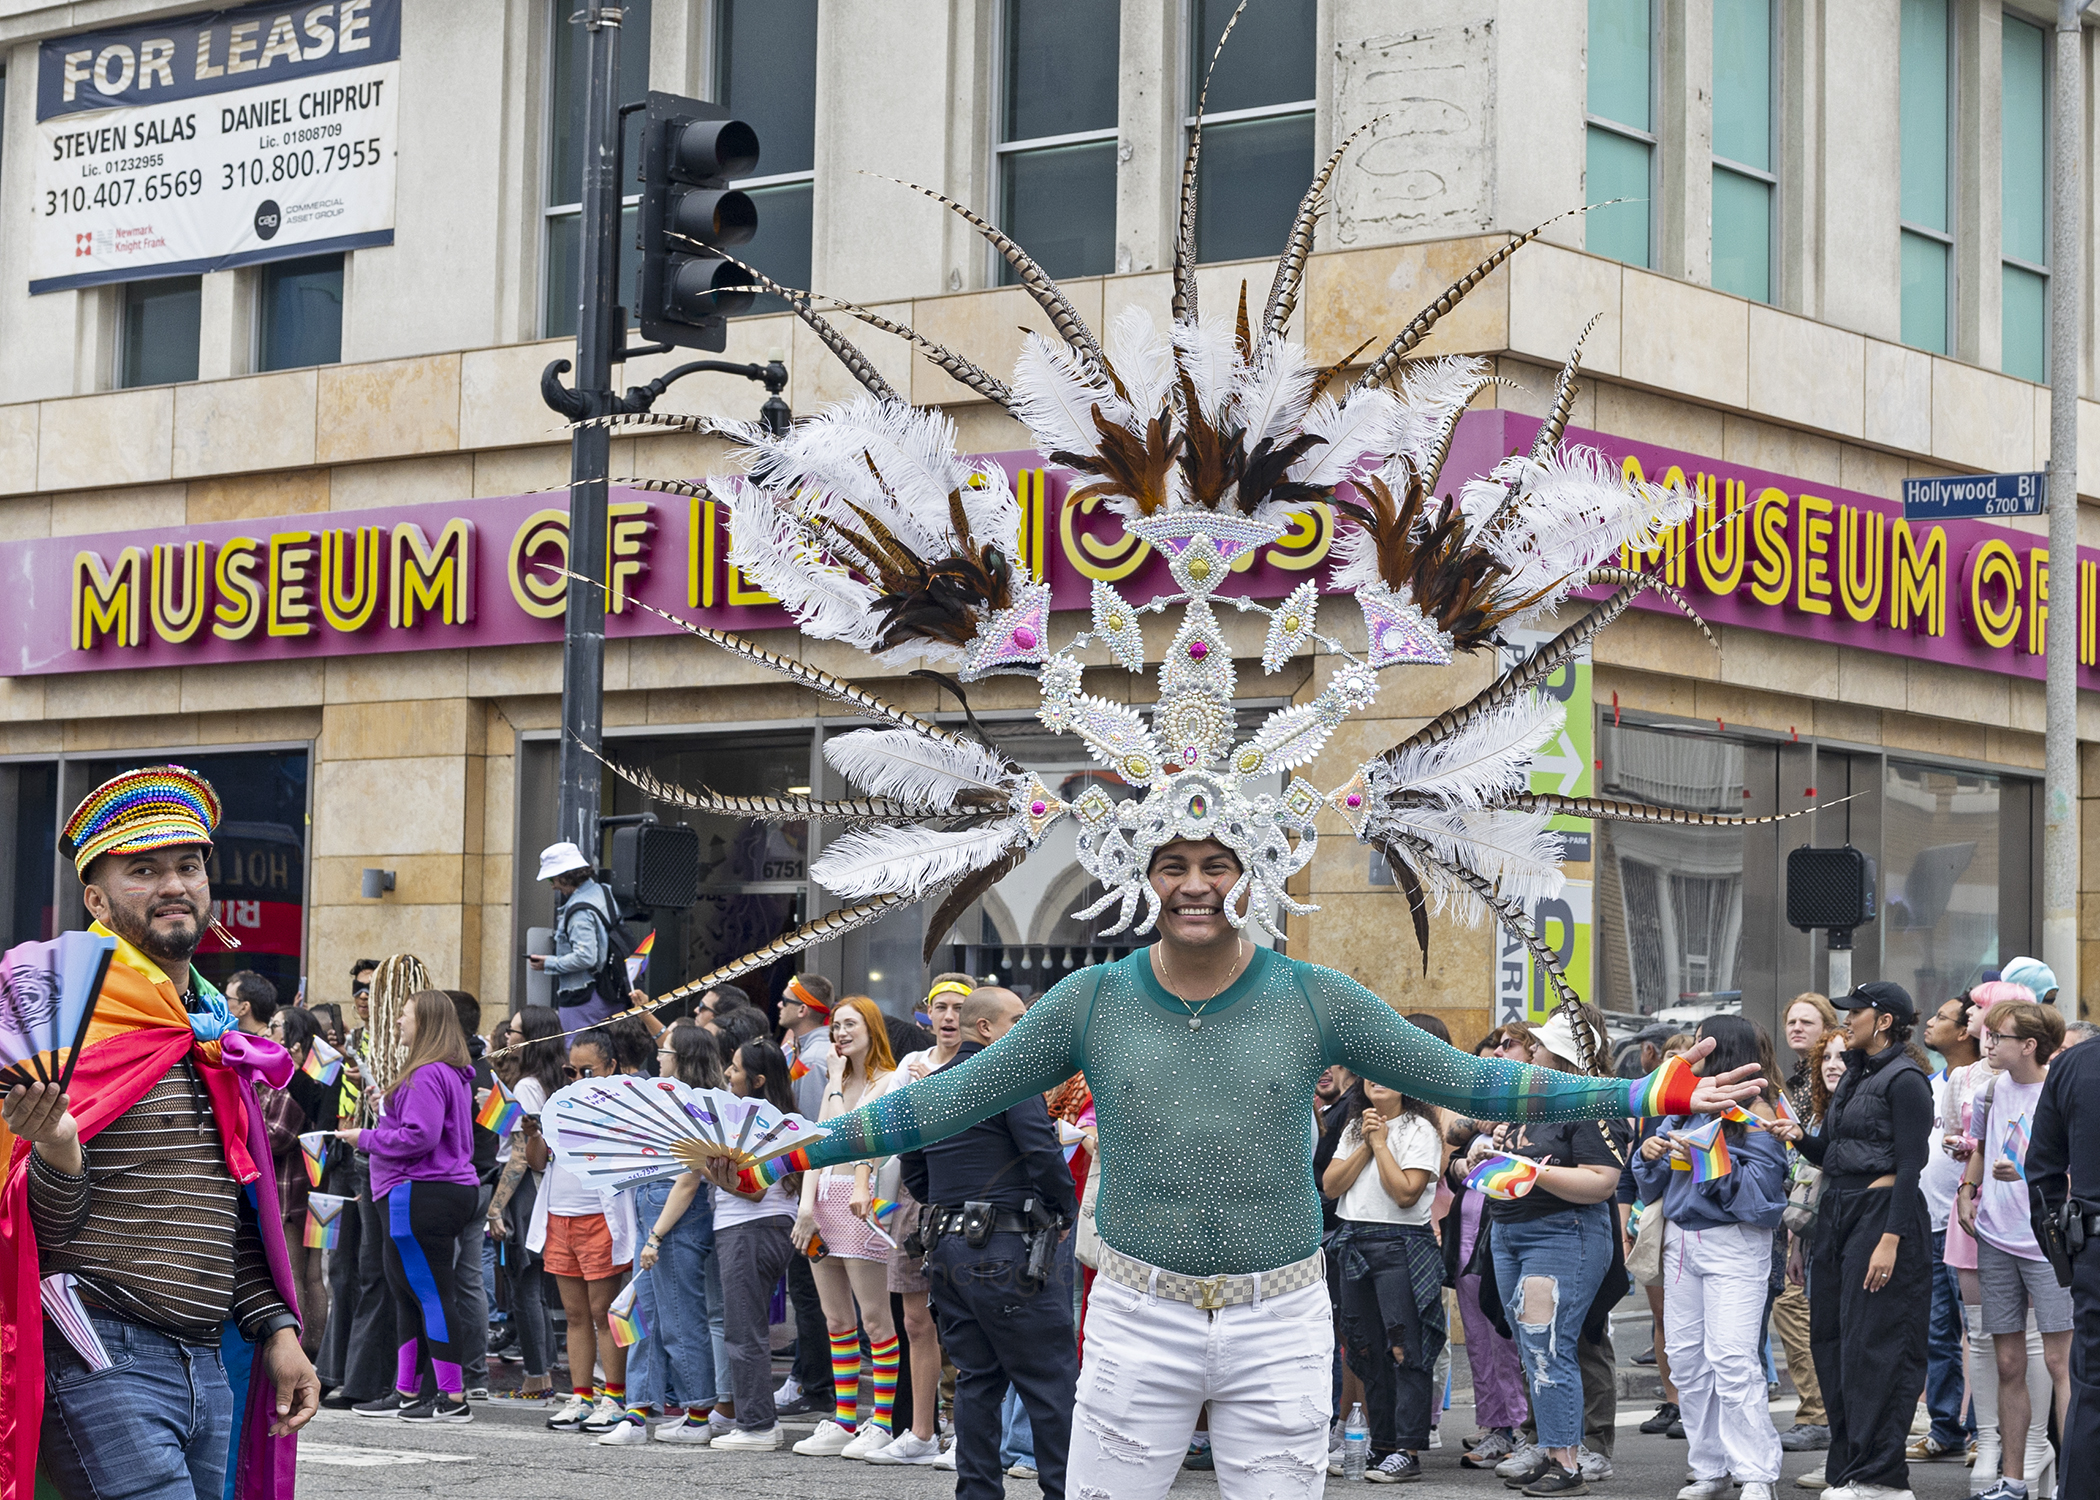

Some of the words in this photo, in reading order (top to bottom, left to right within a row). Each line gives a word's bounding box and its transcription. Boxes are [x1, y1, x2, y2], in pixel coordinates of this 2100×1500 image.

[63, 38, 175, 102] FOR
[194, 0, 372, 81] LEASE
[221, 97, 292, 134] DANIEL
[299, 80, 384, 120] CHIPRUT
[53, 125, 127, 161] STEVEN
[134, 114, 196, 148] SALAS
[259, 135, 280, 150] Lic.
[283, 123, 342, 145] 01808709
[82, 164, 102, 178] Lic.
[105, 153, 164, 174] 01232955
[221, 138, 381, 190] 310.800.7955
[45, 169, 202, 217] 310.407.6569
[285, 198, 344, 214] COMMERCIAL
[286, 213, 314, 224] ASSET
[314, 208, 345, 220] GROUP
[115, 224, 153, 239] Newmark
[115, 241, 142, 254] Knight
[143, 236, 166, 249] Frank
[1907, 477, 1998, 507] Hollywood
[1985, 497, 2019, 514] 6700
[2024, 496, 2035, 512] W
[1621, 455, 1948, 638] MUSEUM
[72, 517, 470, 650] MUSEUM
[507, 501, 651, 619] OF
[763, 860, 803, 879] 6751
